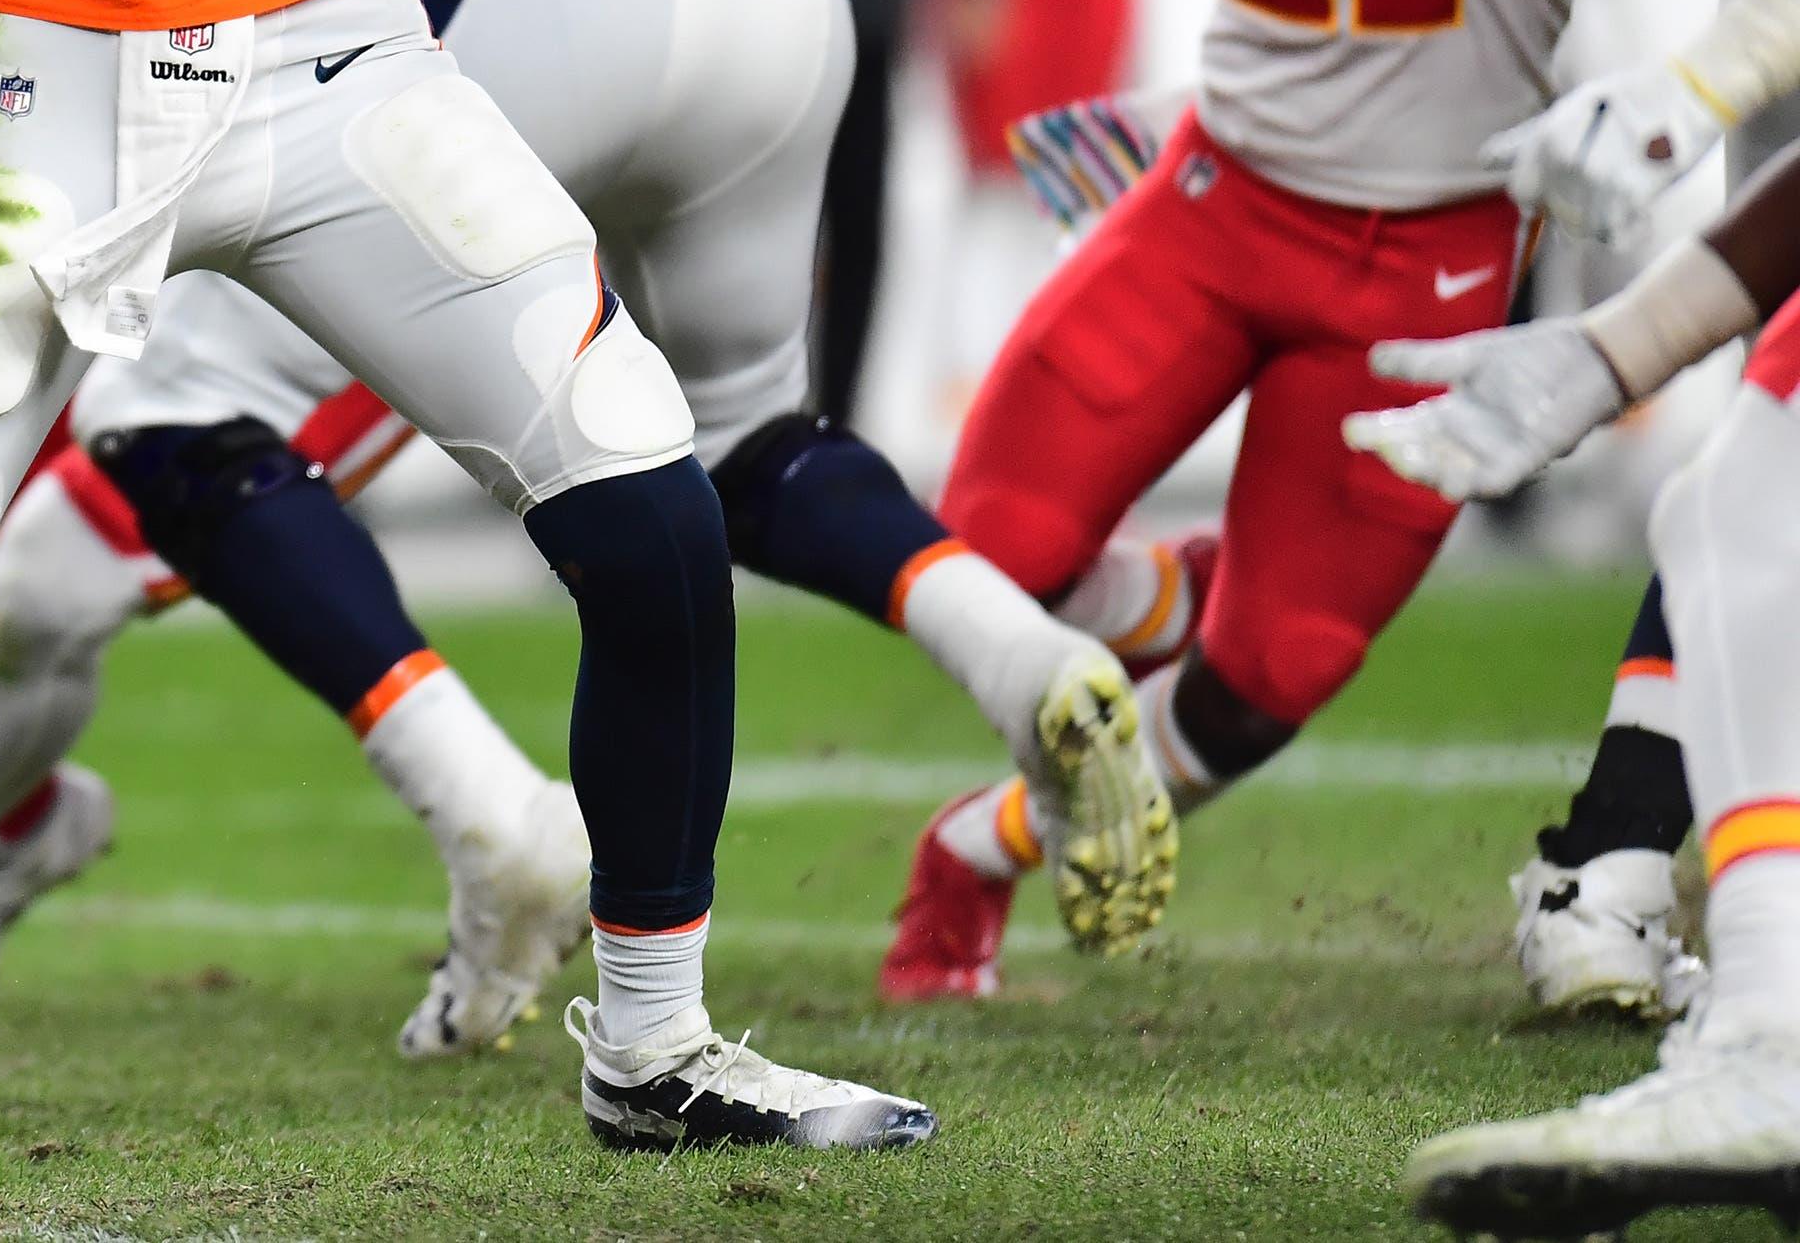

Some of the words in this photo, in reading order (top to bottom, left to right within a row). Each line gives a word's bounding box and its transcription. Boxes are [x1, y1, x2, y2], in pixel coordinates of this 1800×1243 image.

[174, 26, 210, 50] NFL
[150, 60, 228, 83] Wilson
[0, 90, 28, 111] NFL
